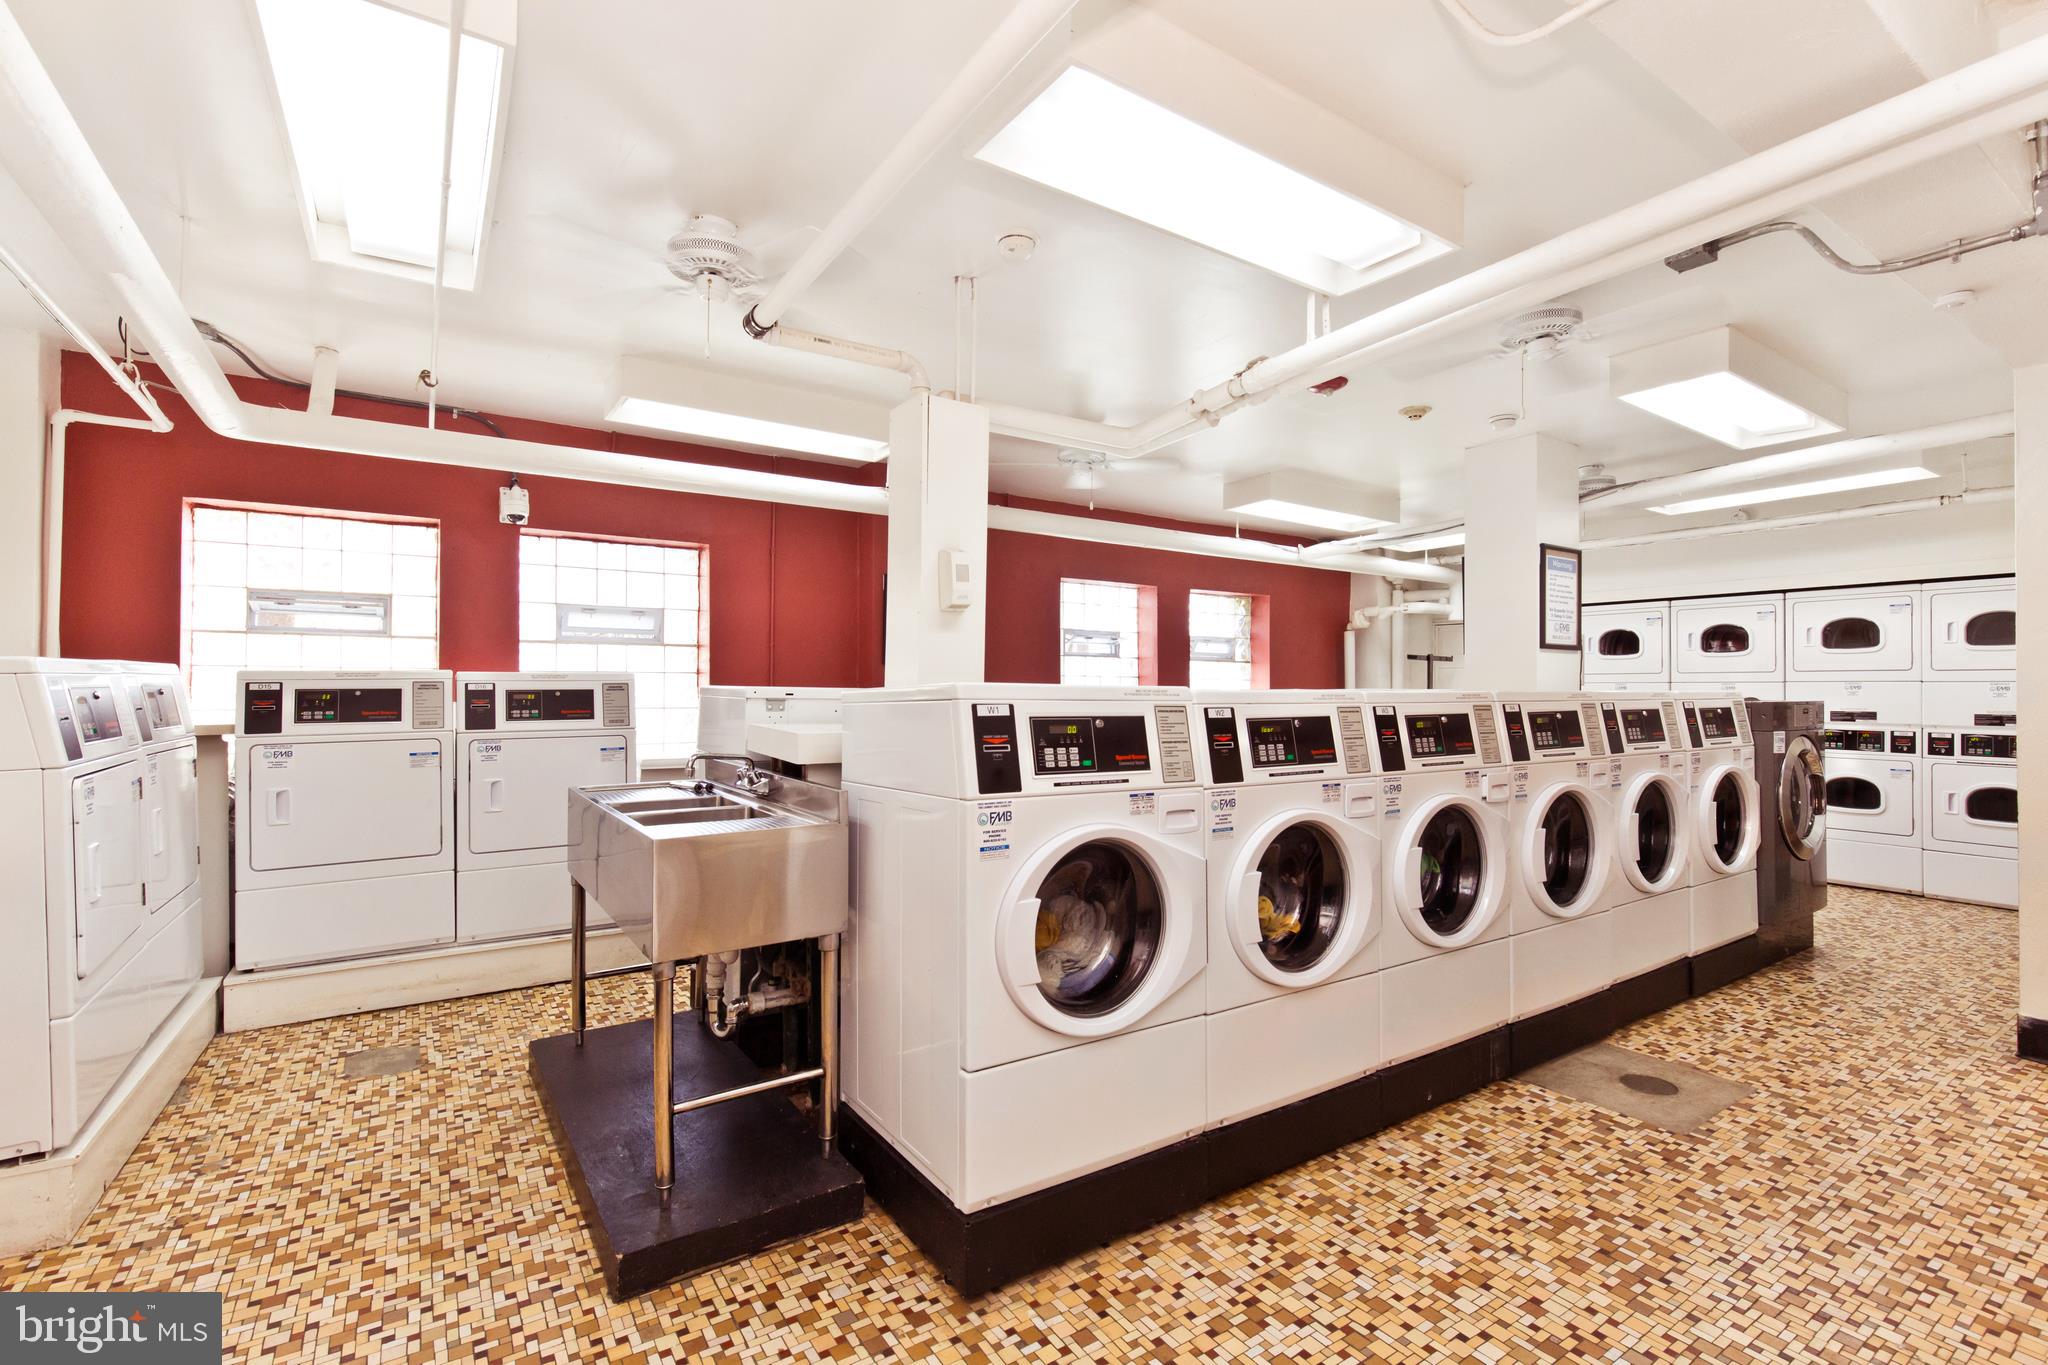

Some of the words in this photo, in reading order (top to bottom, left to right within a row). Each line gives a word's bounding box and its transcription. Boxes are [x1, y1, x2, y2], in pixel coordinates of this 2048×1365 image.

[986, 706, 1000, 715] W1
[1214, 709, 1225, 717] W2
[273, 750, 293, 760] FMB
[1220, 798, 1237, 811] FMB
[989, 811, 1012, 825] FMB
